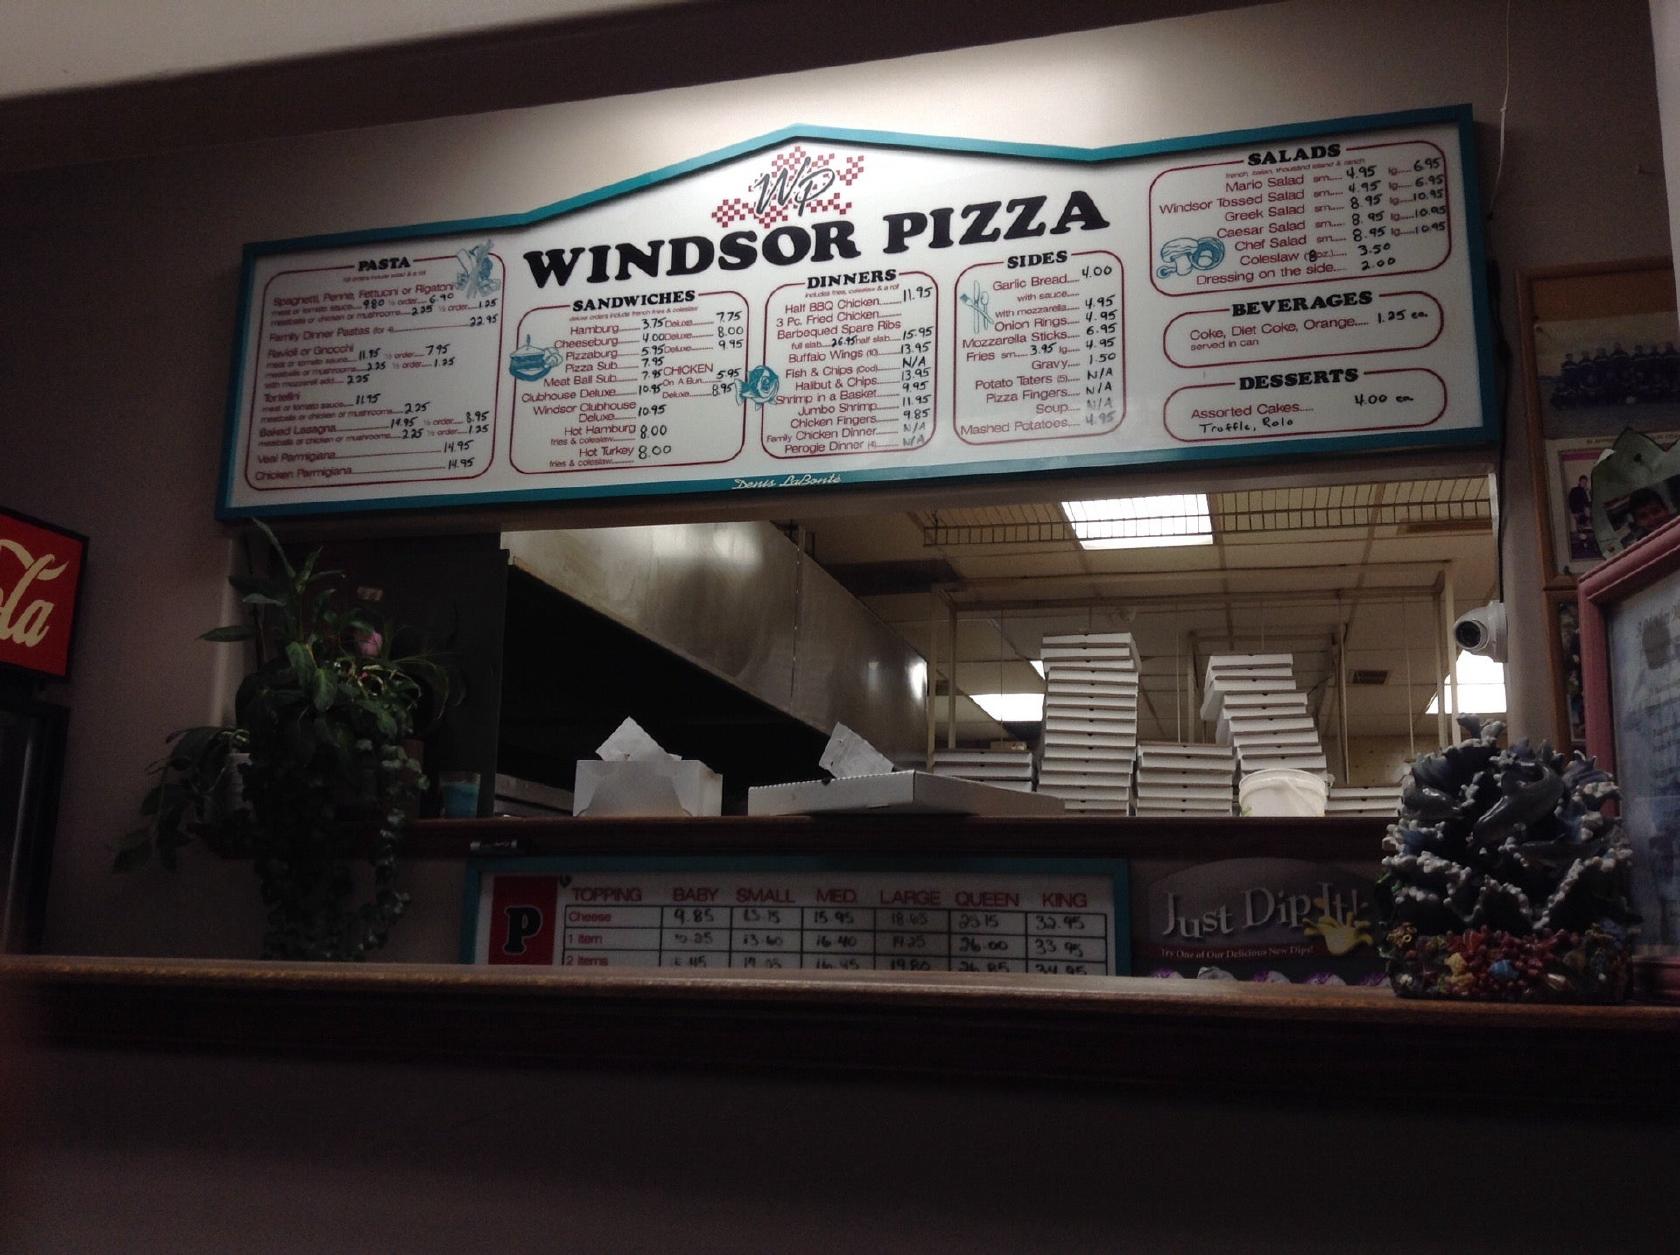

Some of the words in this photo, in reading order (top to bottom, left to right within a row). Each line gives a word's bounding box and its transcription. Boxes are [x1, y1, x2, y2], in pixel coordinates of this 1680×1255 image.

[1248, 143, 1341, 165] SALADS
[1226, 178, 1262, 192] Mario
[1268, 174, 1304, 187] Salad
[1346, 166, 1376, 178] 4.95
[1160, 201, 1212, 214] Windsor
[1217, 195, 1262, 207] Tossed
[1268, 190, 1304, 202] Salad
[1348, 180, 1381, 193] 4.95
[1225, 210, 1264, 221] Greek
[1268, 205, 1304, 217] Salad
[1350, 194, 1383, 209] 8.95
[1217, 226, 1264, 238] Caesar
[1269, 221, 1306, 233] Salad
[1352, 211, 1384, 226] 8.95
[523, 222, 861, 288] WINDSOR
[883, 191, 1109, 253] PIZZA
[1235, 238, 1265, 251] Chef
[1270, 235, 1306, 248] Salad
[1353, 226, 1386, 242] 8.95
[357, 257, 410, 271] PASTA
[1007, 251, 1068, 269] SIDES
[1240, 253, 1299, 265] Coleslaw
[1358, 243, 1391, 256] 3.50
[807, 269, 896, 289] DINNERS
[992, 279, 1026, 291] Garlic
[1031, 274, 1068, 287] Bread
[1082, 265, 1112, 278] 4.00
[1197, 271, 1254, 285] Dressing
[1361, 258, 1396, 271] 2.00
[572, 290, 695, 312] SANDWICHES
[785, 304, 805, 314] Half
[809, 302, 834, 312] BBQ
[837, 297, 880, 310] Chicken
[903, 286, 933, 302] 11.95
[1040, 291, 1067, 300] sauce
[1232, 291, 1373, 317] BEVERAGES
[806, 314, 833, 324] Fried
[837, 310, 879, 322] Chicken
[1017, 304, 1066, 315] mozzarella
[337, 326, 370, 337] Pastas
[570, 324, 619, 336] Hamburg
[642, 317, 666, 330] 3.75
[777, 324, 837, 340] Barbequed
[841, 323, 874, 335] Spare
[878, 320, 901, 330] Ribs
[902, 326, 934, 340] 15.95
[994, 320, 1029, 332] Onion
[1034, 317, 1068, 328] Rings
[1190, 327, 1227, 341] Coke,
[1231, 325, 1257, 337] Diet
[1261, 321, 1298, 335] Coke,
[1304, 317, 1356, 331] Orange
[1378, 310, 1406, 324] 1.25
[554, 337, 618, 349] Cheeseburg
[717, 326, 744, 338] 8.00
[962, 335, 1027, 348] Mozzarella
[1031, 330, 1068, 342] Sticks
[1086, 322, 1118, 335] 6.95
[565, 349, 618, 362] Pizzaburg
[718, 339, 744, 350] 9.95
[788, 351, 826, 363] Buffalo
[829, 348, 863, 361] Wings
[900, 341, 932, 354] 13.95
[1190, 342, 1225, 351] served
[565, 364, 594, 373] Pizza
[597, 361, 618, 371] Sub
[966, 352, 995, 362] Fries
[1032, 359, 1068, 370] Gravy
[543, 377, 571, 387] Meat
[574, 376, 593, 385] Ball
[596, 374, 617, 383] Sub
[663, 364, 713, 376] CHICKEN
[786, 368, 807, 378] Fish
[822, 365, 853, 377] Chips
[795, 380, 832, 391] Halibut
[847, 376, 878, 388] Chips
[901, 367, 931, 381] 13.95
[975, 378, 1013, 390] Potato
[1017, 375, 1052, 386] Taters
[1088, 368, 1113, 380] N/A
[1239, 369, 1359, 390] DESSERTS
[522, 391, 576, 403] Clubhouse
[580, 388, 616, 398] Deluxe
[775, 394, 813, 405] Shrimp
[840, 389, 877, 400] Basket
[902, 381, 929, 393] 9.95
[986, 393, 1018, 403] Pizza
[1022, 388, 1068, 400] Fingers
[1086, 382, 1112, 395] N/A
[533, 405, 577, 415] Windsor
[579, 401, 636, 412] Clubhouse
[638, 404, 667, 416] 10.95
[798, 404, 835, 416] Jumbo
[839, 402, 878, 414] Shrimp
[1036, 403, 1068, 414] Soup
[1191, 405, 1252, 420] Assorted
[1257, 402, 1300, 415] Cakes
[1354, 393, 1387, 406] 4.00
[578, 413, 615, 423] Deluxe
[791, 416, 833, 429] Chicken
[837, 415, 876, 427] Fingers
[960, 422, 1009, 435] Mashed
[1014, 419, 1068, 432] Potatoes
[564, 427, 582, 436] Hot
[586, 424, 636, 435] Hamburg
[640, 424, 667, 438] 8.00
[767, 435, 792, 443] Family
[796, 429, 838, 441] Chicken
[842, 428, 876, 438] Dinner
[443, 440, 474, 453] 14.95
[579, 448, 599, 457] Hot
[602, 446, 634, 456] Turkey
[638, 445, 672, 459] 8.00
[784, 443, 825, 454] Perogie
[829, 441, 863, 451] Dinner
[448, 457, 475, 470] 14.95
[572, 888, 642, 902] TOPPING
[672, 887, 719, 902] BABY
[736, 888, 795, 903] SMALL
[880, 890, 941, 905] LARGE
[955, 891, 1020, 908] QUEEN
[1042, 892, 1087, 908] KING
[569, 911, 612, 922] Cheese
[674, 908, 714, 924] 9.85
[1162, 891, 1235, 938] Just
[1241, 887, 1311, 928] Dip
[503, 904, 544, 955] P
